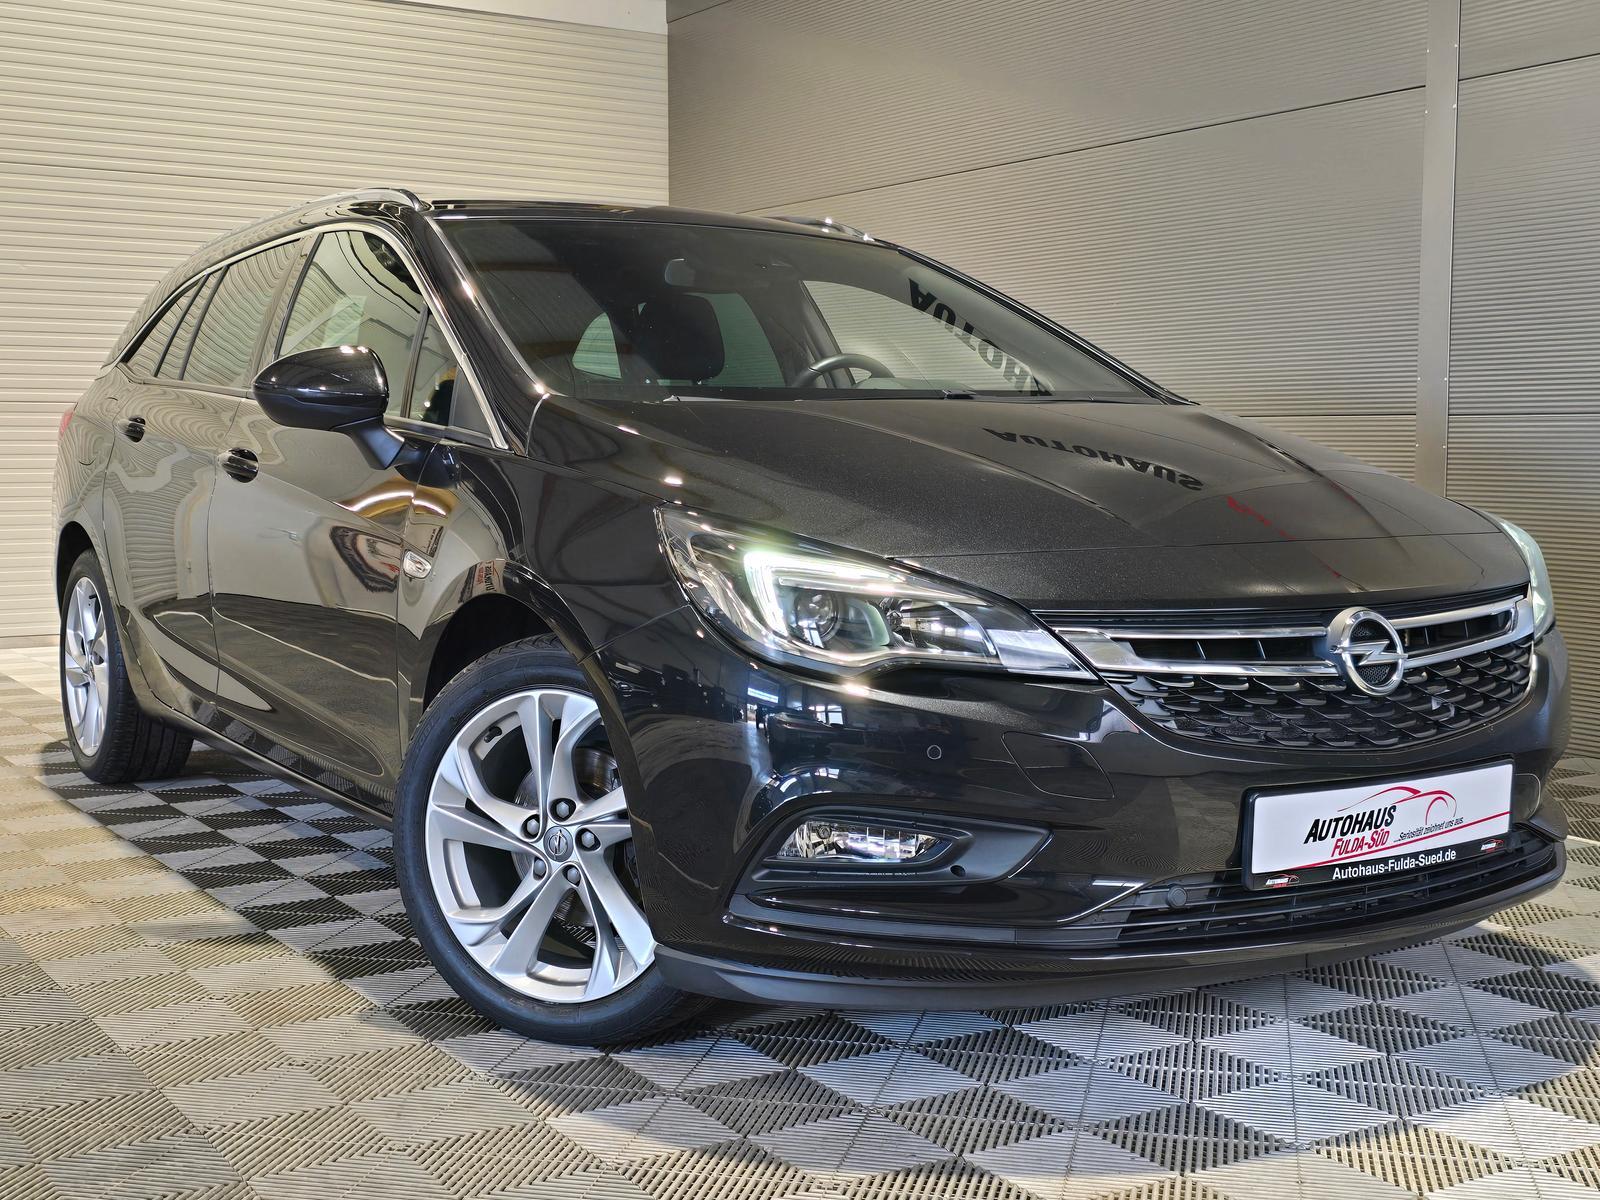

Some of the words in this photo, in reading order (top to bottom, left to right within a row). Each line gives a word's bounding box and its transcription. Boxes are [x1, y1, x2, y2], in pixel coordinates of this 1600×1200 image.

[1304, 805, 1396, 844] AUTOHAUS
[1331, 830, 1390, 857] FULDA-SÜD
[1332, 849, 1456, 880] Autohaus-Fulda-Sued.de
